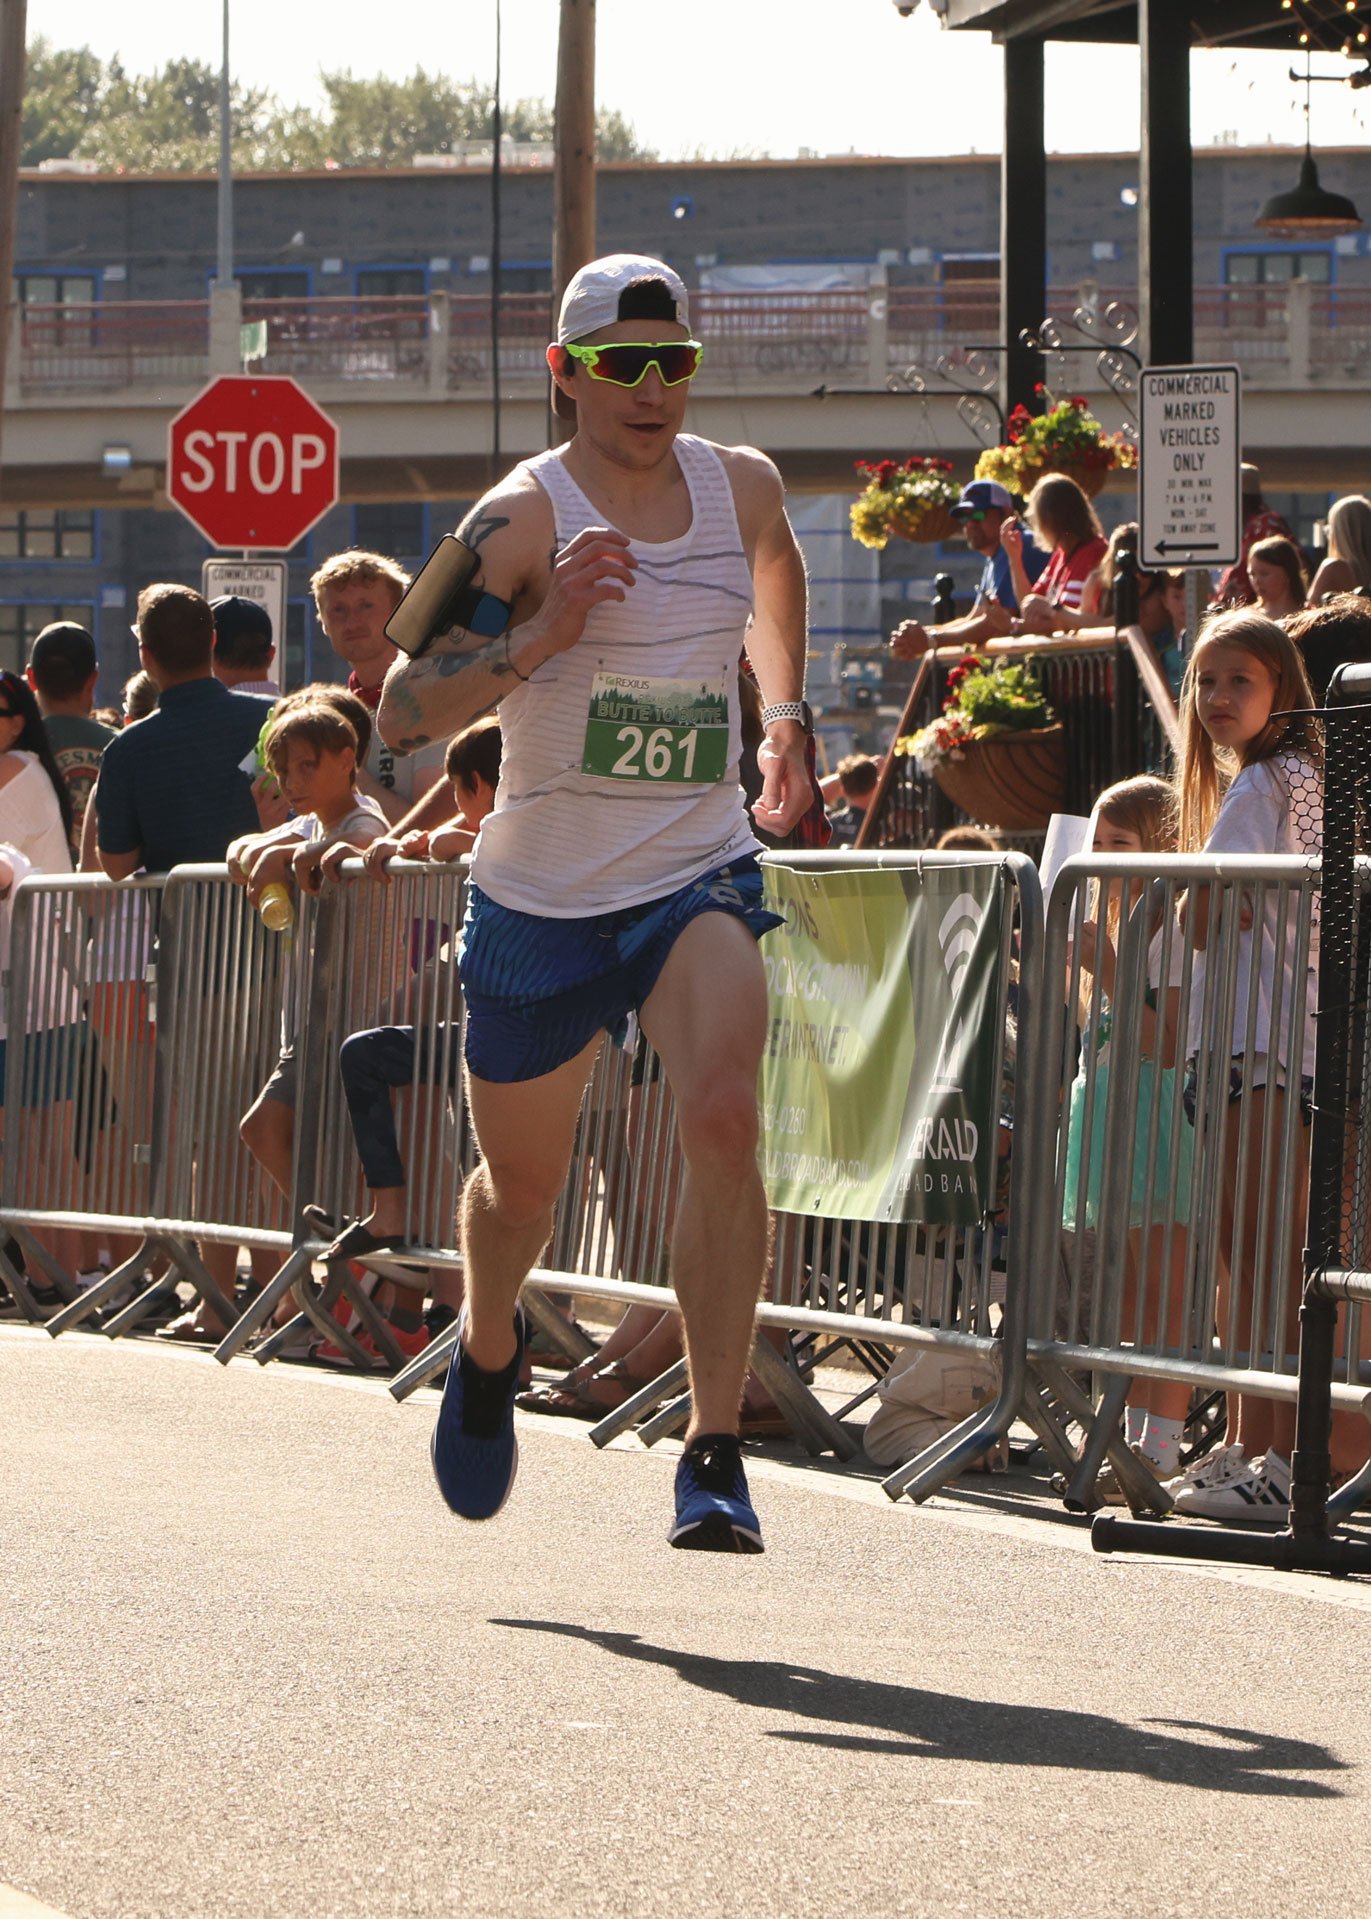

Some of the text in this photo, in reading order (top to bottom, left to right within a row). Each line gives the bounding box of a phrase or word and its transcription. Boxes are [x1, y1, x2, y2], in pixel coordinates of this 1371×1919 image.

[1149, 375, 1230, 397] COMMERCIAL
[1163, 401, 1216, 421] MARKED
[1160, 427, 1220, 447] VEHICLES
[180, 430, 327, 495] STOP
[1173, 453, 1206, 472] ONLY
[1163, 522, 1216, 533] TOW AWAY ZONE
[212, 567, 276, 582] COMMERCIAL
[223, 584, 265, 598] MARKED
[616, 677, 650, 690] REXIUS
[597, 700, 722, 724] BUTTE TO BUTTE
[611, 726, 698, 779] 261
